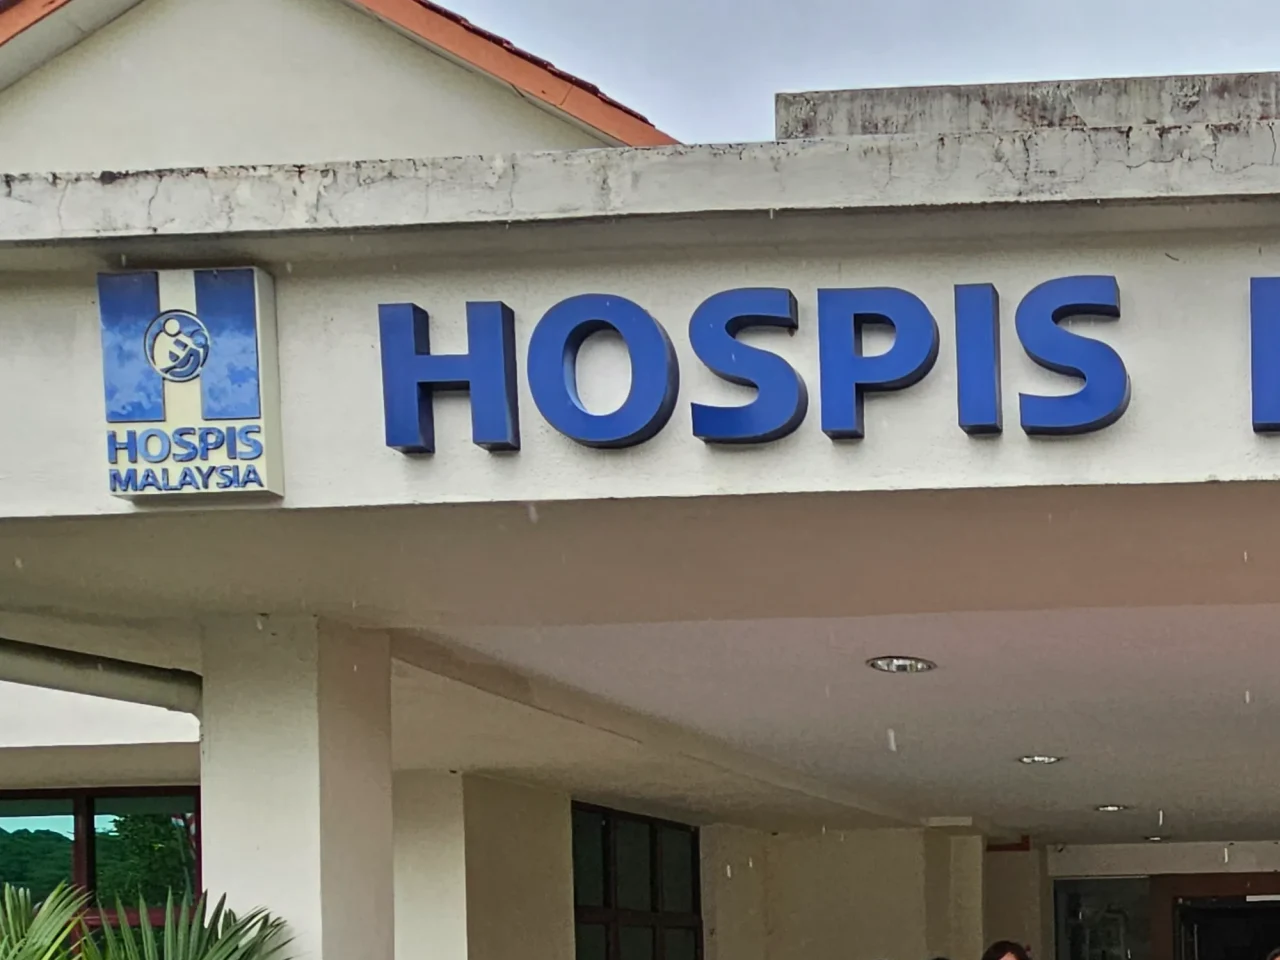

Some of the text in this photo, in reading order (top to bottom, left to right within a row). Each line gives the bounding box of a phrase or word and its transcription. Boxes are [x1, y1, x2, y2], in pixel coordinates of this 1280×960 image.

[377, 275, 1131, 453] HOSPIS
[107, 425, 263, 464] HOSPIS
[109, 464, 265, 492] MALAYSIA
